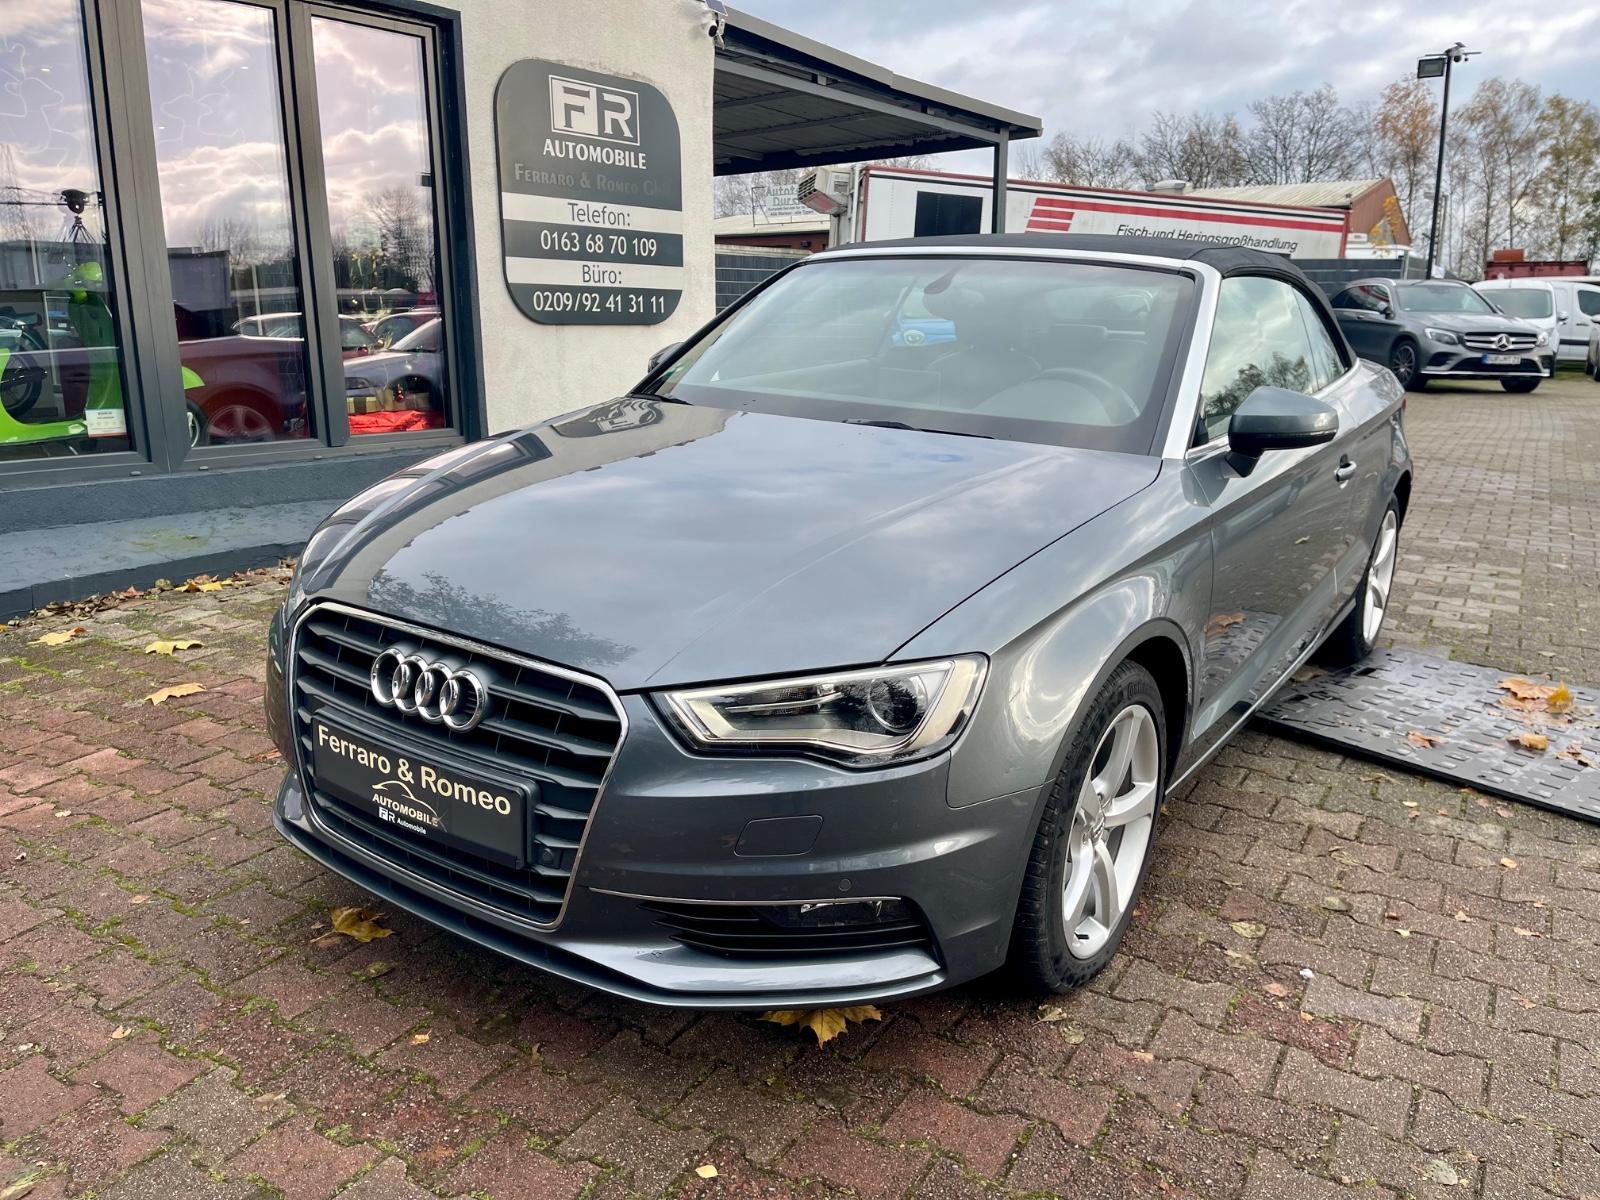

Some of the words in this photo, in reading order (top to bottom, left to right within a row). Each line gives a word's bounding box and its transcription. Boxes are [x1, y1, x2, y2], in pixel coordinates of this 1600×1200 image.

[543, 138, 647, 170] AUTOMOBILE
[579, 172, 592, 189] &
[567, 202, 631, 227] Telefon:
[540, 230, 580, 252] 0163
[585, 234, 604, 254] 68
[609, 236, 627, 255] 70
[632, 238, 657, 257] 109
[582, 264, 622, 285] Büro:
[533, 291, 601, 313] 0209/92
[606, 294, 622, 313] 41
[629, 294, 644, 313] 31
[650, 296, 665, 314] 11
[317, 724, 391, 774] Ferraro
[397, 757, 415, 784] &
[420, 765, 511, 815] Romeo
[372, 793, 439, 827] AUTOMOBILE
